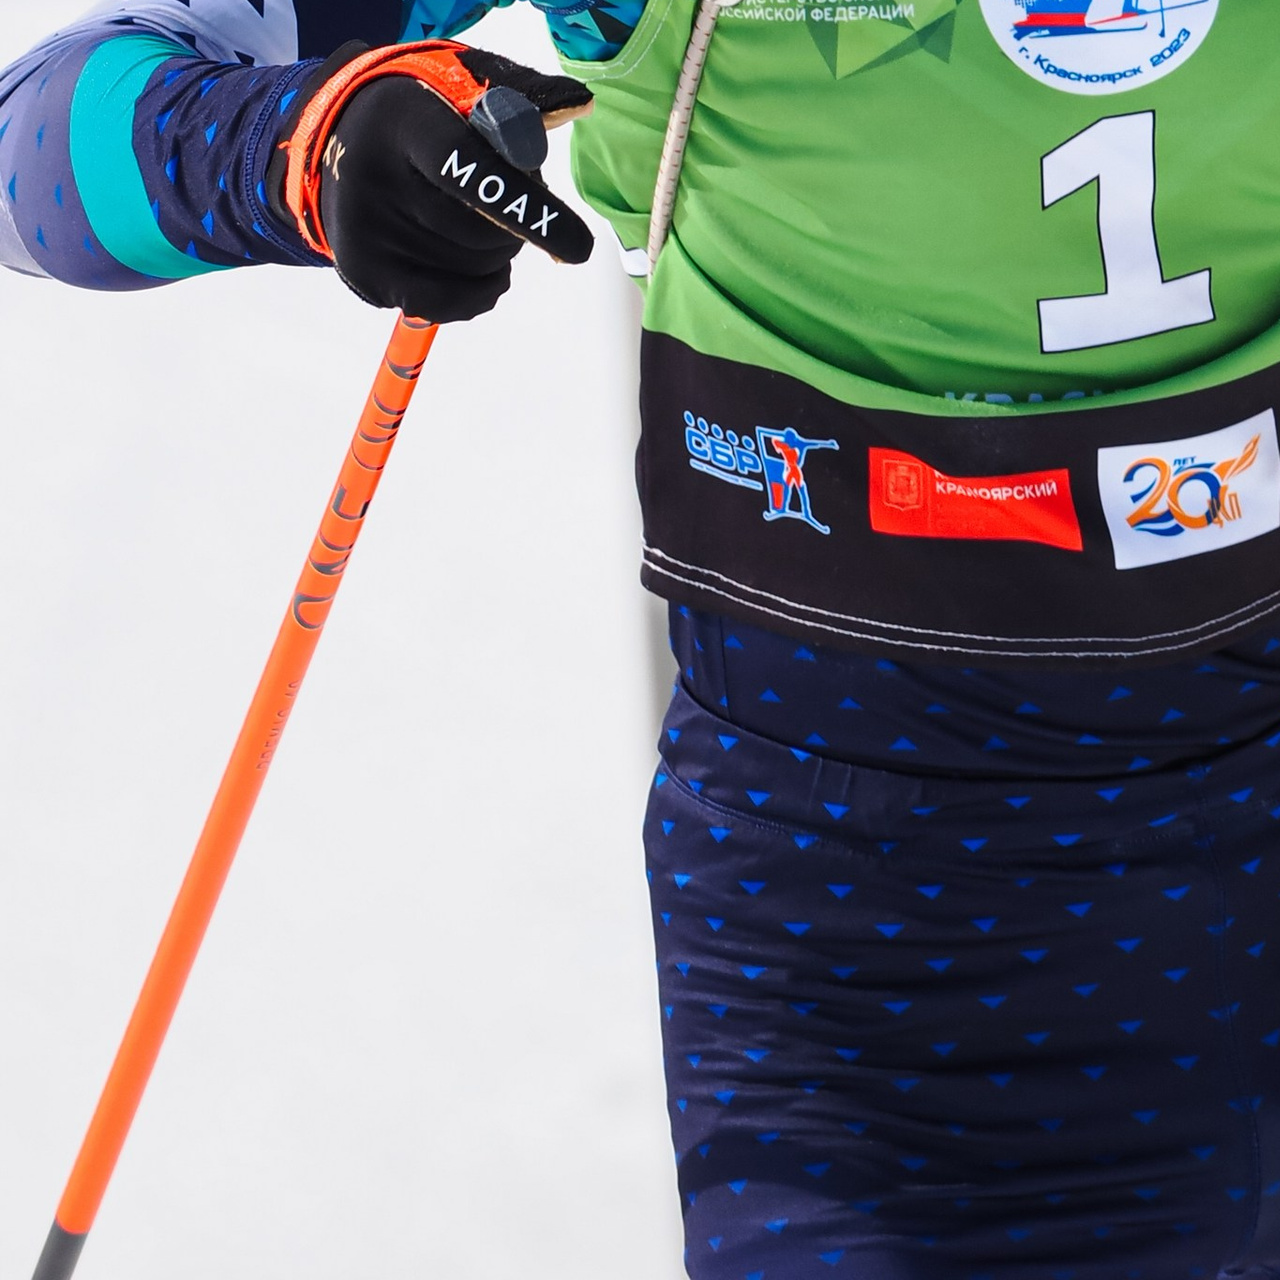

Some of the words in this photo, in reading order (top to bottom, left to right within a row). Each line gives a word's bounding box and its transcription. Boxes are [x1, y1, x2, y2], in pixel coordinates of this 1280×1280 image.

[720, 3, 806, 22] ССИЙСКОЙ
[811, 3, 915, 23] ФЕДЕРАЦИИ
[1033, 53, 1144, 84] Красноярск
[1149, 27, 1191, 68] 2023
[441, 149, 559, 237] MOAX
[1037, 109, 1216, 354] 1
[685, 426, 763, 475] СБР
[1173, 456, 1197, 467] ЛЕТ
[1123, 455, 1222, 536] 20
